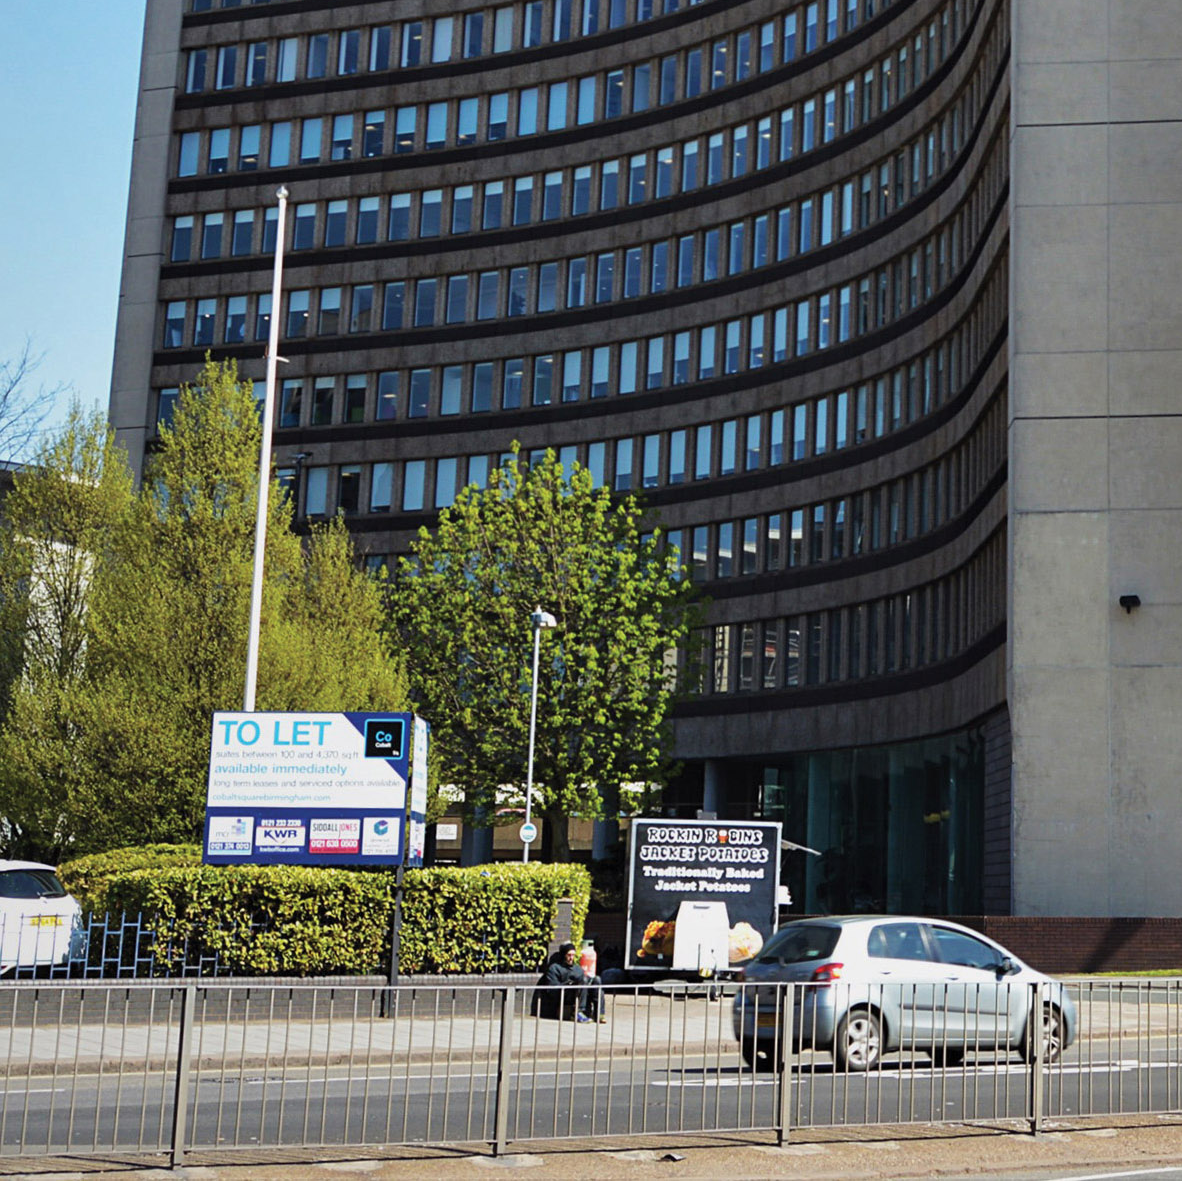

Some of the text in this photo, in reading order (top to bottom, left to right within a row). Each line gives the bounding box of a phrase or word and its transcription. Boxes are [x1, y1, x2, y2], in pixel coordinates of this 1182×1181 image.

[218, 720, 332, 746] TO LET
[375, 731, 393, 742] Co
[216, 750, 240, 758] suites
[242, 750, 277, 758] between
[281, 750, 295, 758] 100
[298, 750, 314, 758] and
[214, 763, 347, 775] available immediately
[213, 780, 401, 788] long term leases and serviced options available
[312, 823, 358, 835] SIDDALL JONES
[647, 827, 702, 843] ROCKIN
[640, 845, 696, 862] JACKET
[642, 865, 764, 879] Traditionally Baked
[654, 880, 751, 892] Jacket Potatoes
